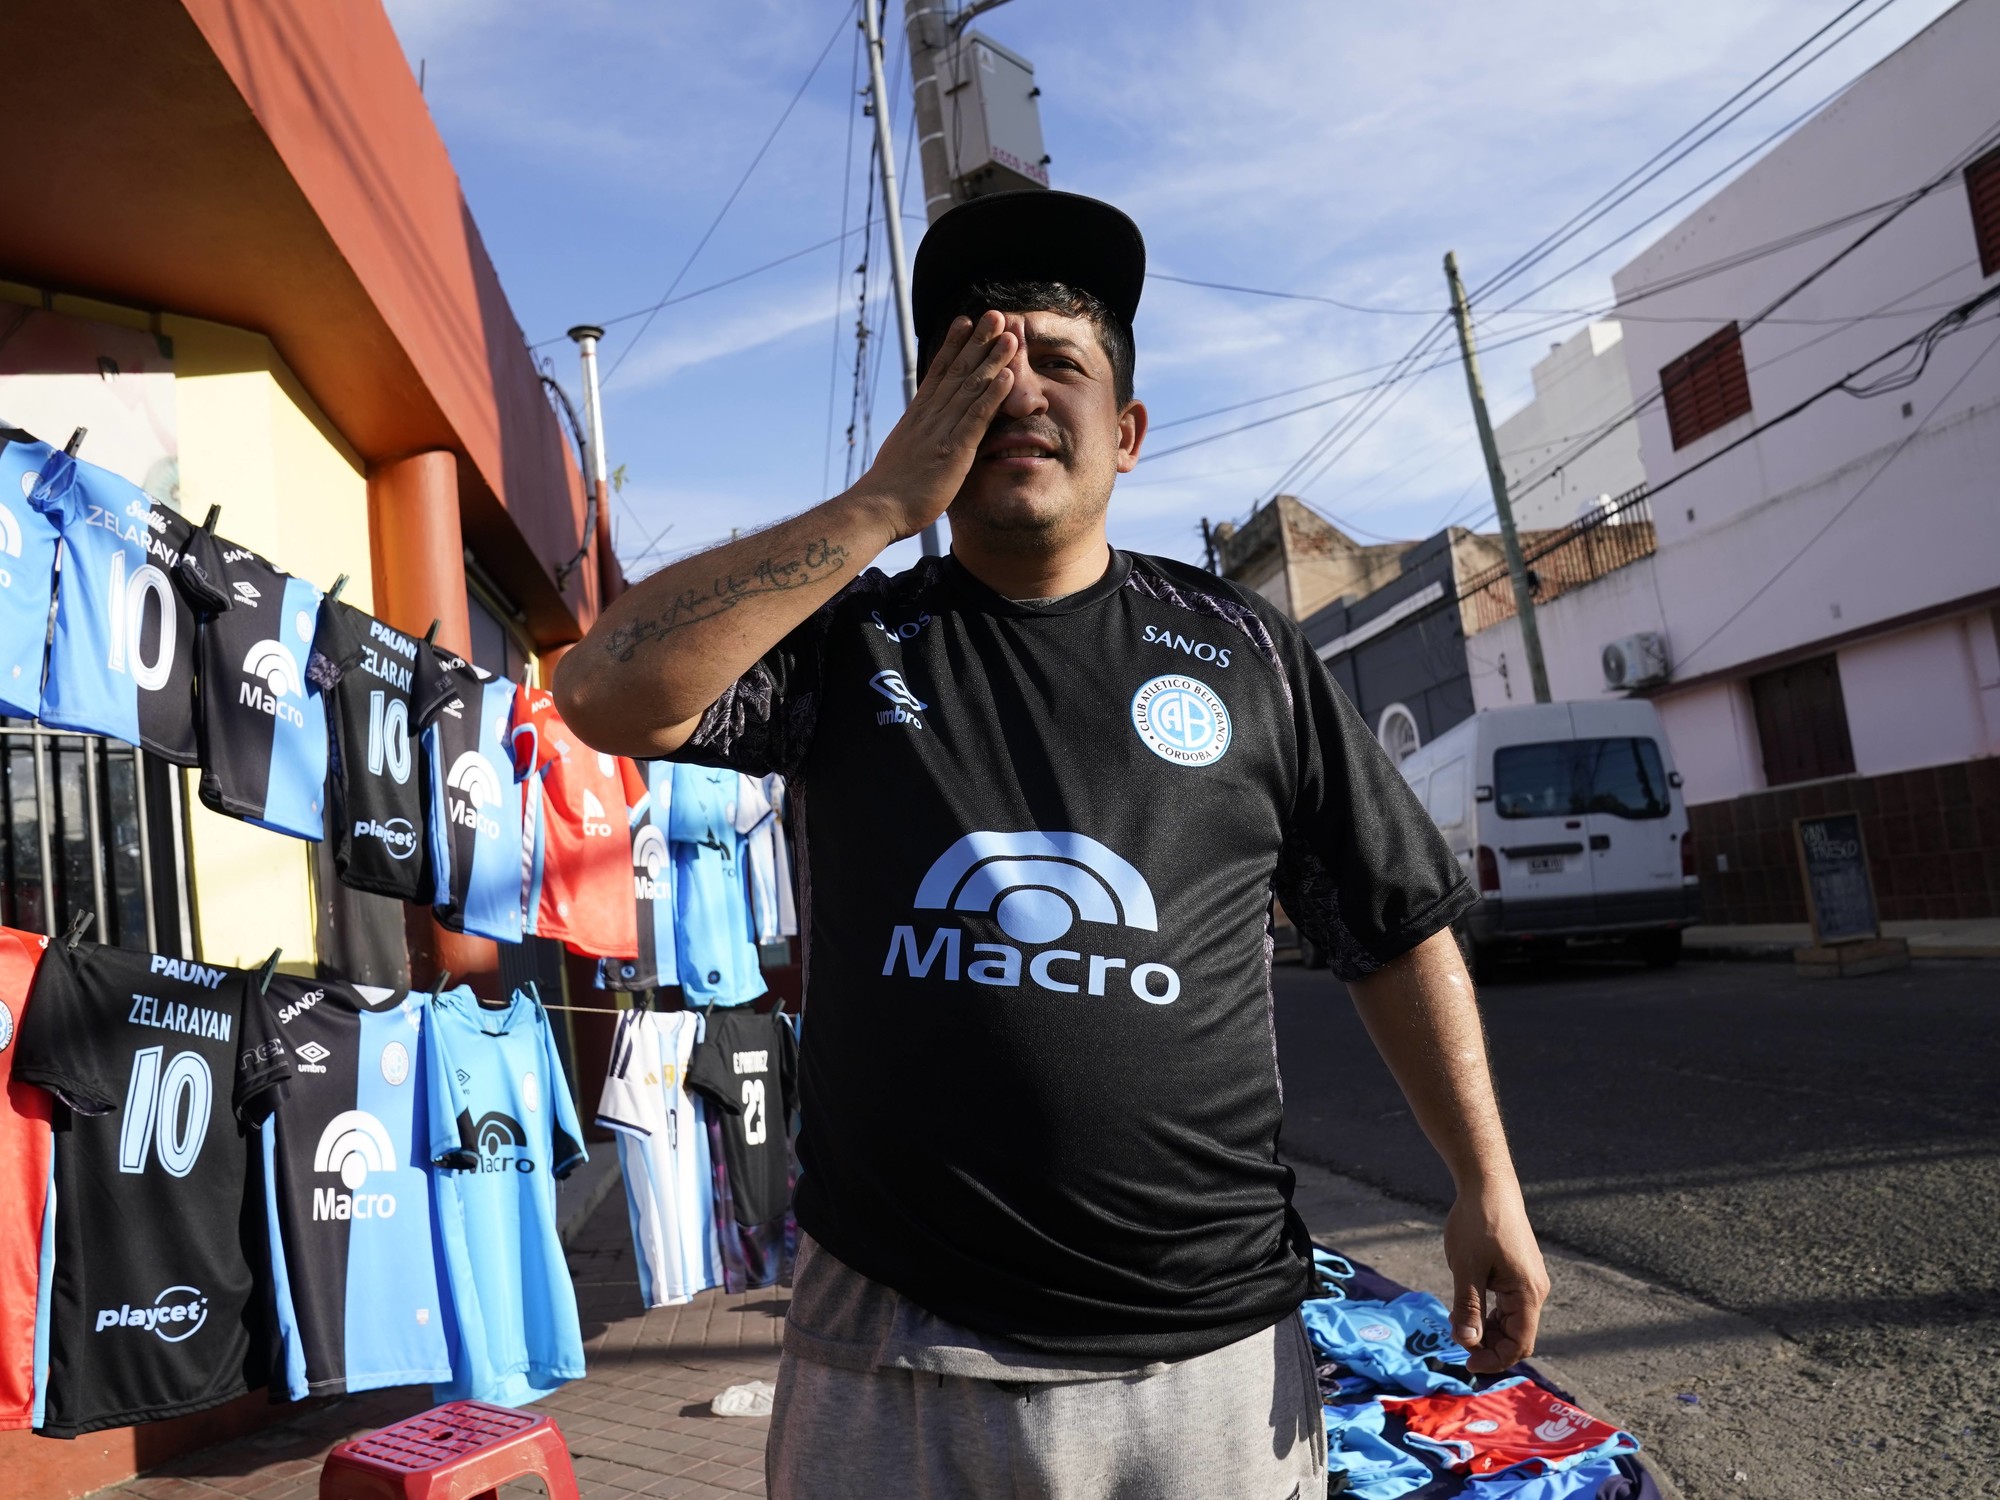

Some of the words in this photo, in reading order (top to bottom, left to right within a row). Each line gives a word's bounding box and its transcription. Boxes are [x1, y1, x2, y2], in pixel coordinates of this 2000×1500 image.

[86, 504, 179, 568] ZELARAY
[107, 549, 177, 691] 10
[370, 620, 418, 662] PAUNY
[1142, 625, 1232, 668] SANOS
[239, 681, 304, 729] Macro
[1141, 679, 1191, 703] ATLETICO
[877, 705, 923, 730] umbro
[1137, 703, 1150, 732] CLUB
[1194, 686, 1225, 743] BELGRANO
[368, 690, 412, 785] 10
[1157, 743, 1213, 761] CORDOBA
[449, 797, 500, 840] Macro
[150, 955, 227, 989] PAUNY
[881, 925, 1181, 1006] Macro
[128, 994, 232, 1042] ZELARAYAN
[278, 989, 325, 1024] SANOS
[298, 1063, 327, 1074] umbro
[119, 1045, 213, 1178] 10
[742, 1079, 767, 1146] 23
[312, 1187, 397, 1222] Macro
[95, 1301, 201, 1332] playcet
